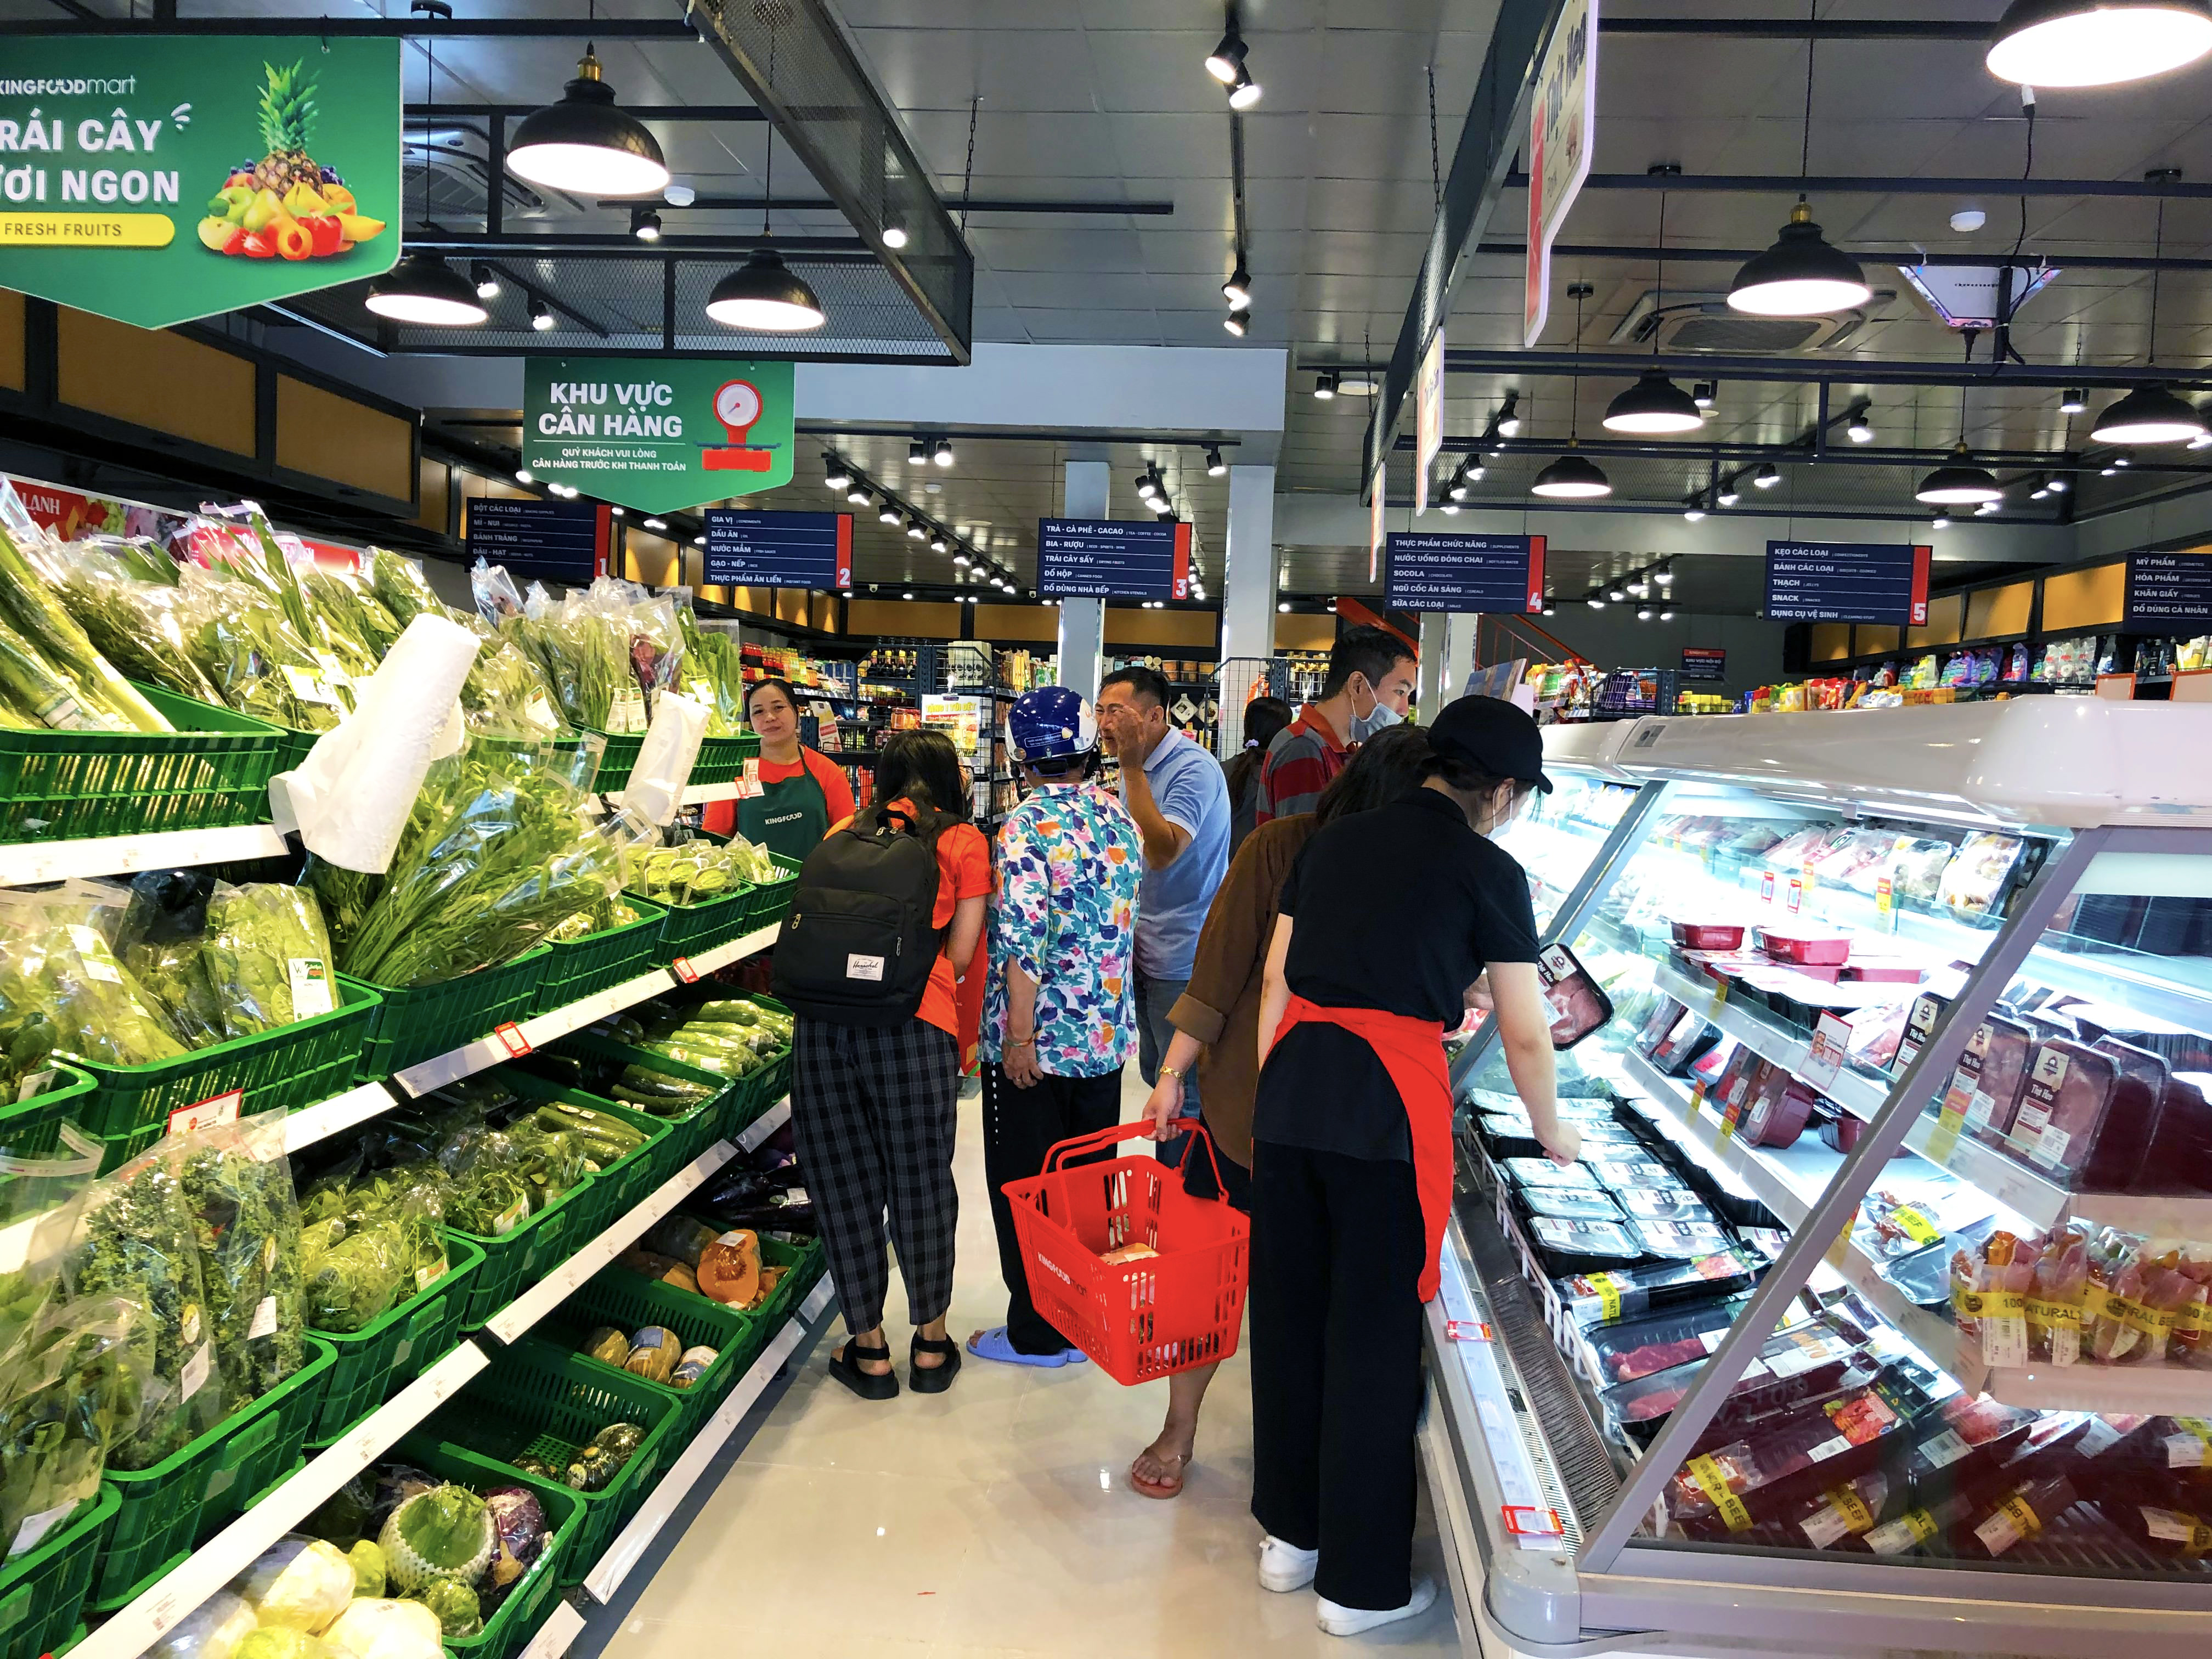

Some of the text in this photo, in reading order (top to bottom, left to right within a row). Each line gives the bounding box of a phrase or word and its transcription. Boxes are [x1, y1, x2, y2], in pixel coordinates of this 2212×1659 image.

[78, 107, 162, 151] CÂY
[0, 164, 179, 202] ƠI NGON
[5, 223, 122, 236] FRESH FRUITS
[550, 381, 673, 411] KHU VỰC
[539, 406, 682, 437] CÂN HÀNG
[562, 447, 657, 459] QUÝ KHÁCH VUI LÒNG
[532, 458, 551, 468] CÂN
[552, 458, 578, 469] HÀNG
[580, 459, 610, 469] TRƯỚC
[628, 461, 659, 470] THANH
[661, 460, 686, 471] TOÁN
[473, 504, 488, 512] BỘT
[728, 529, 738, 538] ĂN
[1046, 523, 1060, 532] TRÀ
[1066, 524, 1076, 533] CÀ
[1078, 525, 1092, 534] PHÊ
[711, 544, 731, 552] NƯỚC
[732, 543, 751, 552] MẮM
[1064, 540, 1084, 549] RƯỢU
[1395, 539, 1416, 548] THỰC
[1418, 537, 1441, 548] PHẨM
[1442, 539, 1463, 548] CHỨC
[1465, 539, 1487, 548] NĂNG
[1045, 554, 1062, 562] TRÁI
[1063, 554, 1078, 562] CÂY
[1079, 554, 1094, 563] SẤY
[1395, 553, 1416, 562] NƯỚC
[1418, 553, 1439, 562] UỐNG
[1441, 554, 1463, 563] ĐÓNG
[1775, 548, 1828, 558] KẸO CÁC LOẠI
[600, 558, 606, 574] 1
[711, 560, 725, 568] GẠO
[731, 558, 746, 567] NẾP
[2151, 556, 2175, 566] PHẨM
[1045, 568, 1055, 577] ĐỒ
[1057, 569, 1072, 579] HỘP
[1797, 562, 1814, 571] CÁC
[1815, 565, 1834, 574] LOẠI
[710, 574, 730, 583] THỰC
[731, 573, 753, 582] PHẨM
[754, 574, 765, 583] ĂN
[839, 568, 850, 585] 2
[2135, 572, 2179, 582] HÓA PHẨM
[1044, 583, 1054, 591] ĐỒ
[1056, 583, 1076, 592] DÙNG
[1077, 584, 1094, 592] NHÀ
[1095, 584, 1109, 594] BẾP
[1176, 579, 1187, 596] 3
[1410, 583, 1427, 592] CỐC
[1428, 584, 1439, 592] ĂN
[1441, 585, 1462, 593] SÁNG
[1773, 579, 1800, 587] THẠCH
[1392, 599, 1444, 610] SỮA CÁC LOẠI
[1530, 592, 1542, 610] 4
[1914, 603, 1926, 621] 5
[2133, 603, 2208, 613] ĐỒ DÙNG CÁ NHÂN
[1771, 610, 1793, 618] DỤNG
[1795, 610, 1805, 619] CỤ
[1808, 609, 1818, 619] VỆ
[765, 812, 803, 825] KINGFOOD
[853, 960, 879, 969] Herschel
[2025, 1304, 2077, 1320] ATURAL
